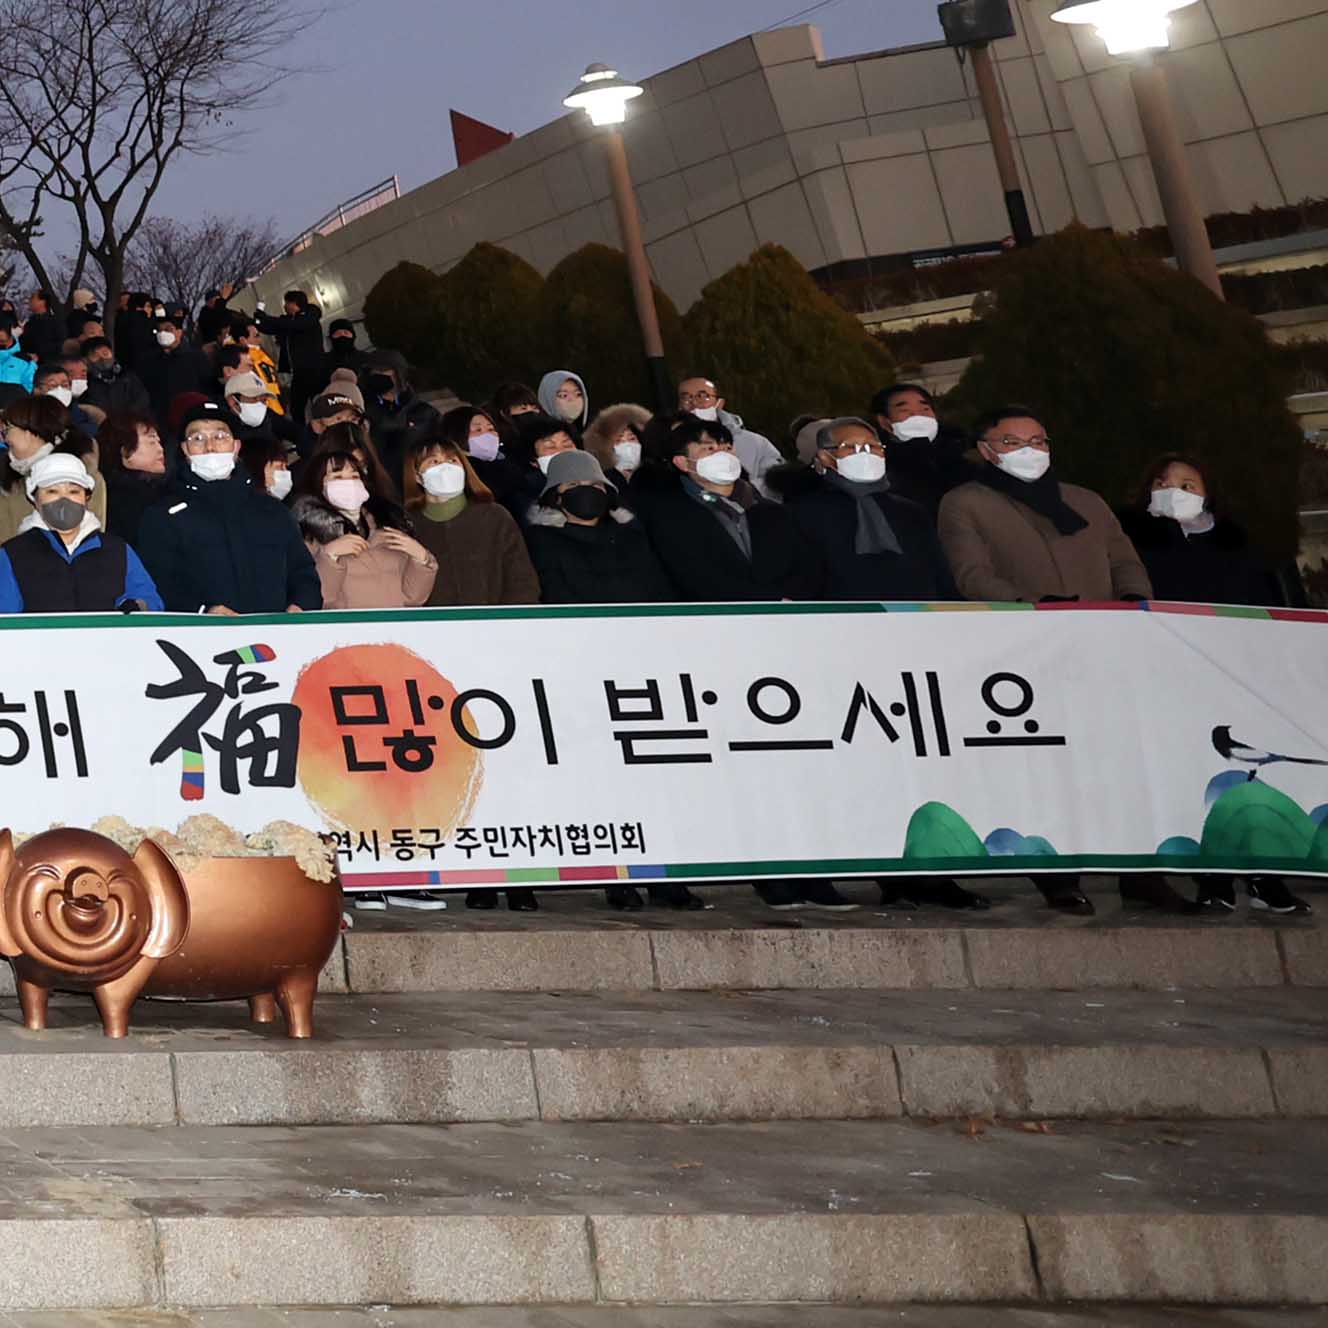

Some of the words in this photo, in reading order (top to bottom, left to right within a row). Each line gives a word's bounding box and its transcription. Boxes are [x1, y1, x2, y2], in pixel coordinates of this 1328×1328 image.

[145, 638, 301, 801] 福
[329, 678, 559, 773] 많이
[603, 671, 1067, 765] 받으세요
[389, 826, 446, 860] 동구
[453, 821, 647, 859] 주민자치협의회
